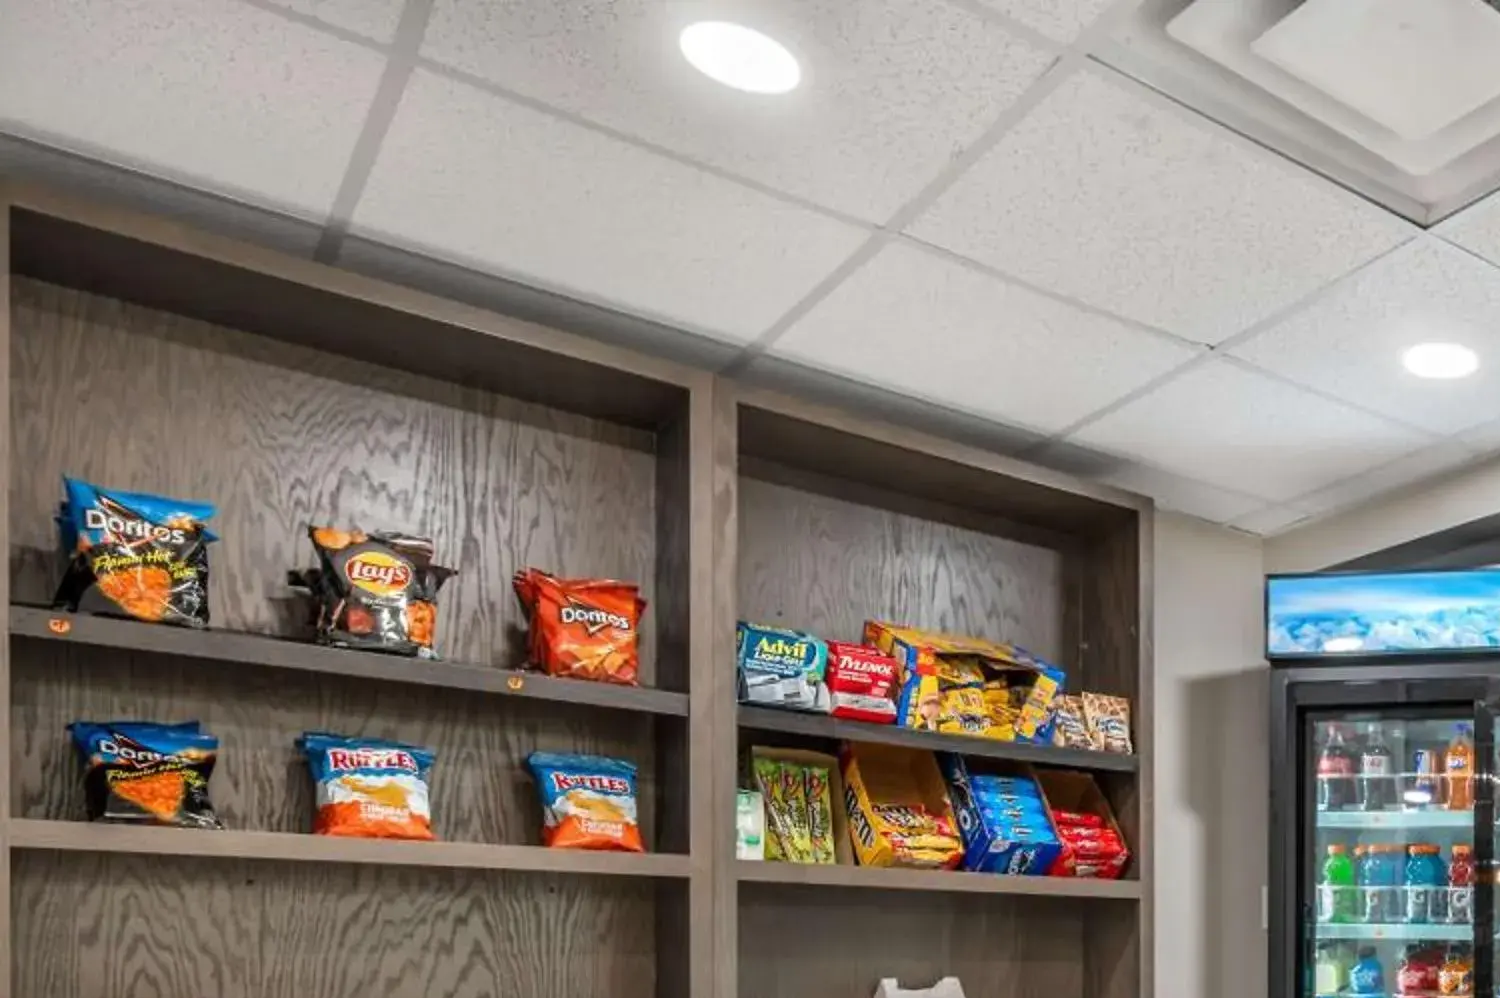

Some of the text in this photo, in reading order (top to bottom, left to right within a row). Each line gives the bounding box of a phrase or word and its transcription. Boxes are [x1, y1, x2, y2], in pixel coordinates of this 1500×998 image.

[86, 509, 185, 544] Doritos
[561, 607, 629, 629] Doritos
[756, 636, 806, 659] Advil
[839, 655, 893, 675] TYLENOL
